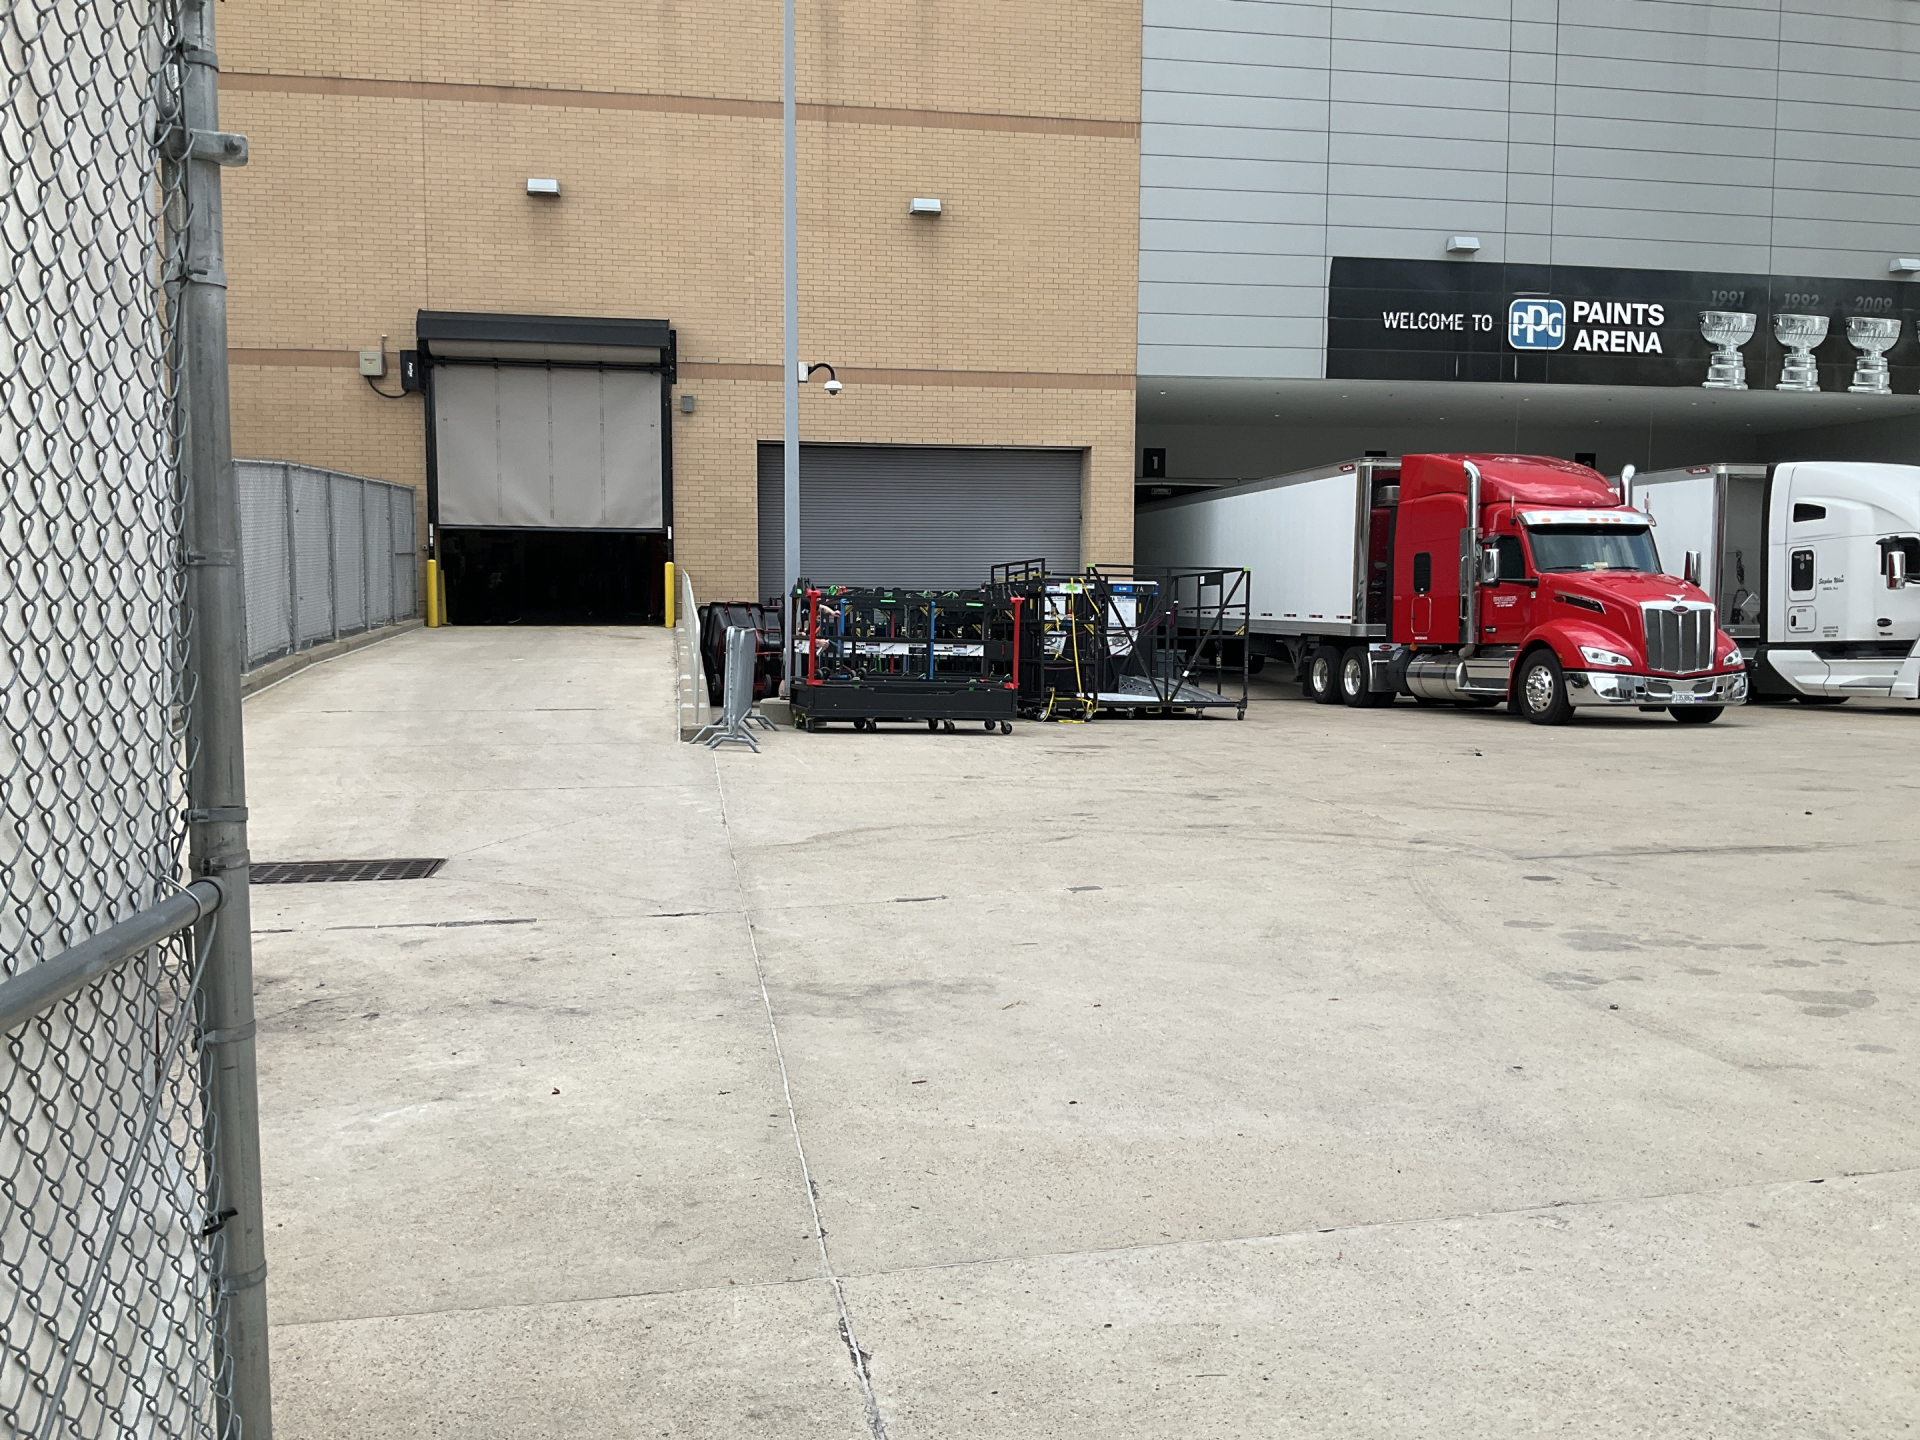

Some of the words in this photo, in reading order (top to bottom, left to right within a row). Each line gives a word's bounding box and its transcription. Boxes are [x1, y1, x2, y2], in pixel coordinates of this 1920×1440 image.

[1709, 290, 1746, 308] 1991
[1781, 293, 1820, 310] 1992
[1854, 295, 1893, 314] 2009
[1383, 311, 1464, 331] WELCOME
[1472, 314, 1493, 332] TO
[1573, 301, 1665, 326] PAINTS
[1512, 304, 1562, 344] PPG
[1573, 329, 1663, 354] ARENA
[1152, 456, 1159, 470] 1
